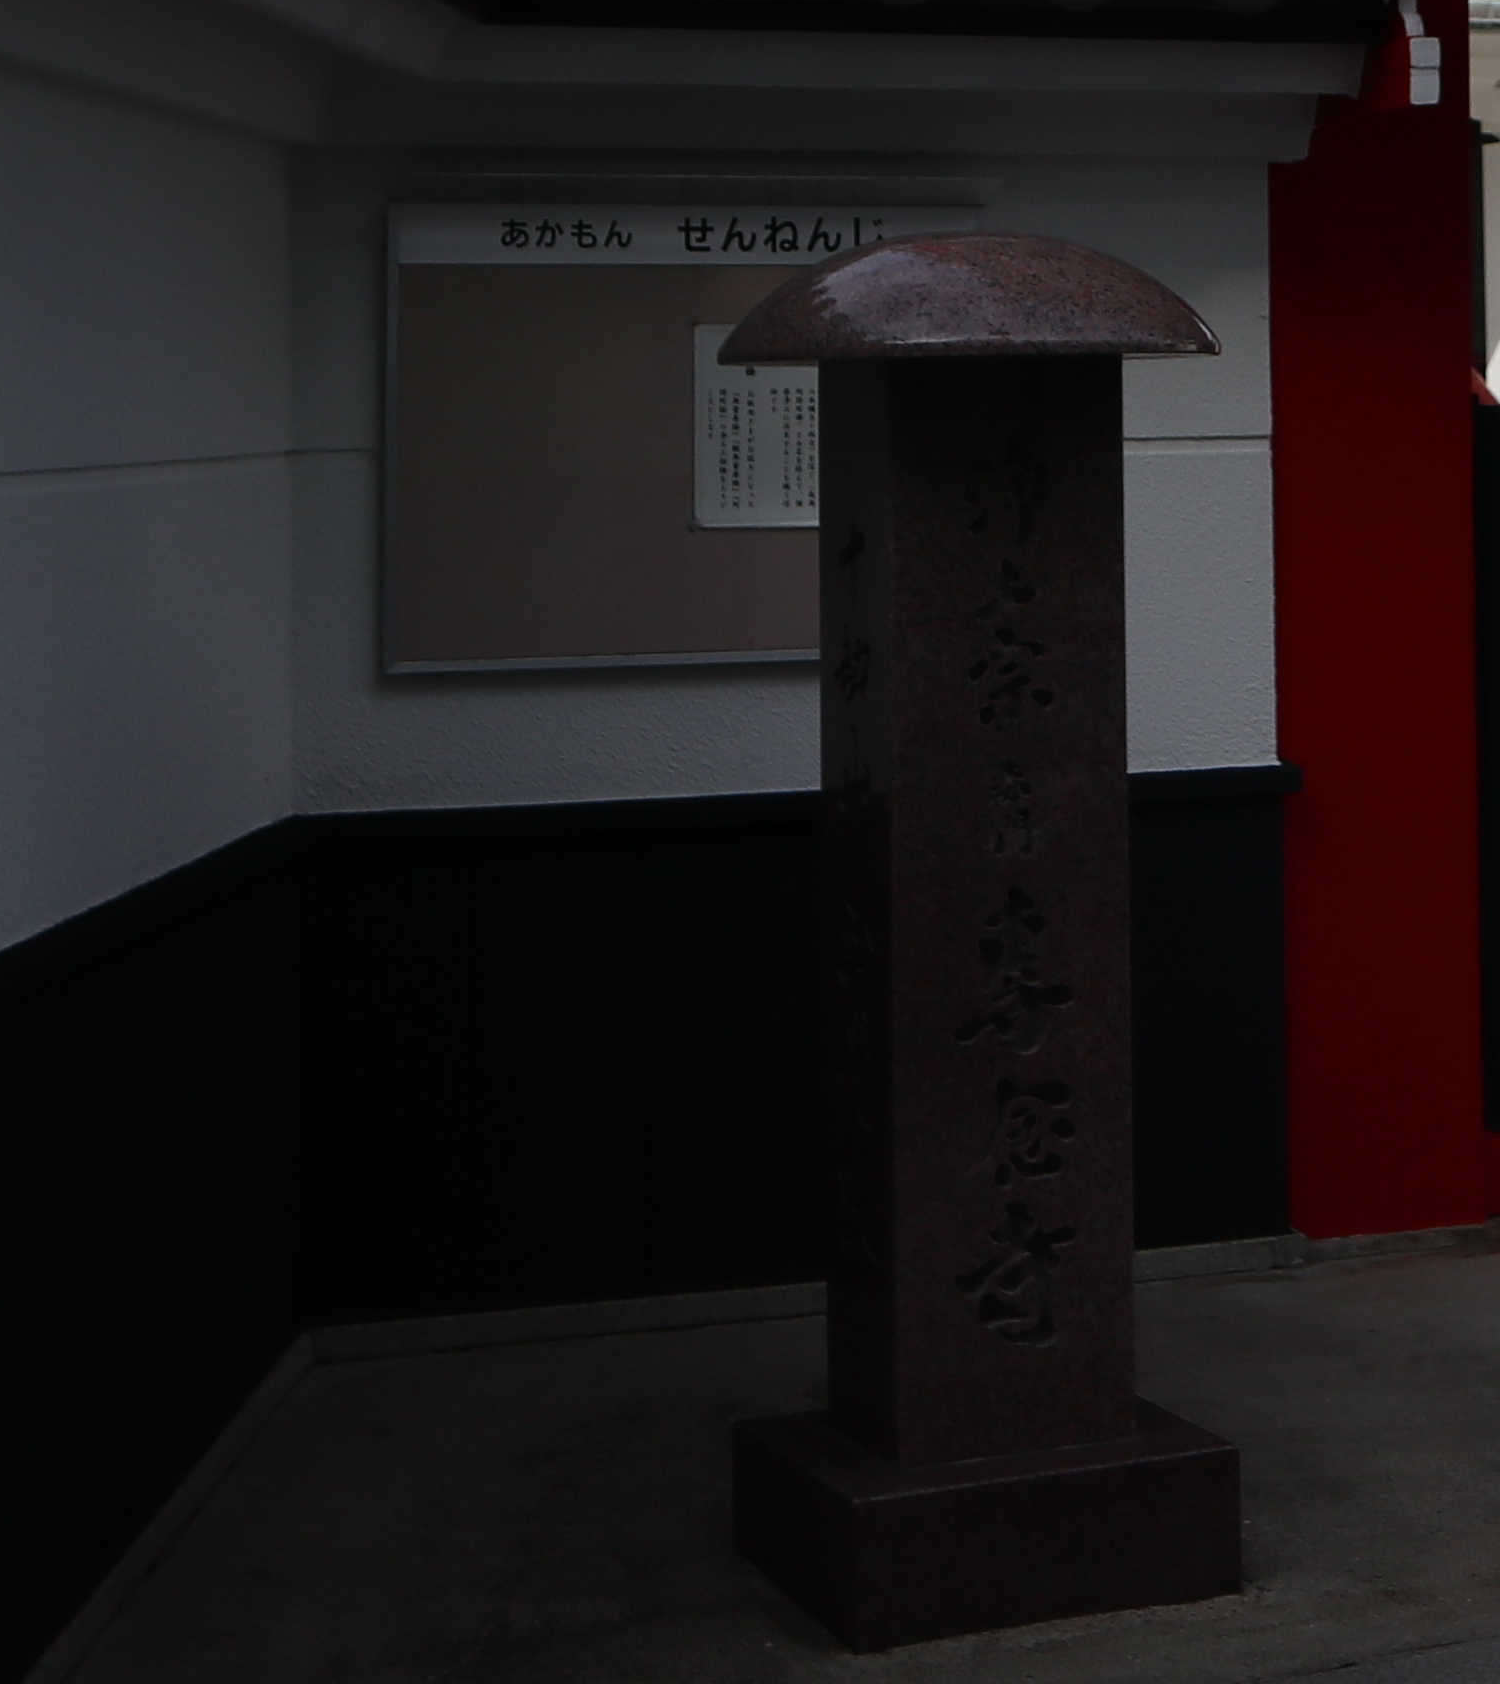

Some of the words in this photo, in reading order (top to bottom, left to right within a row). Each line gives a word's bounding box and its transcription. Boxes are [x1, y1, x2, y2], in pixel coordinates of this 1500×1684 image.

[500, 217, 633, 249] あかもん
[677, 215, 883, 253] せんねんじ
